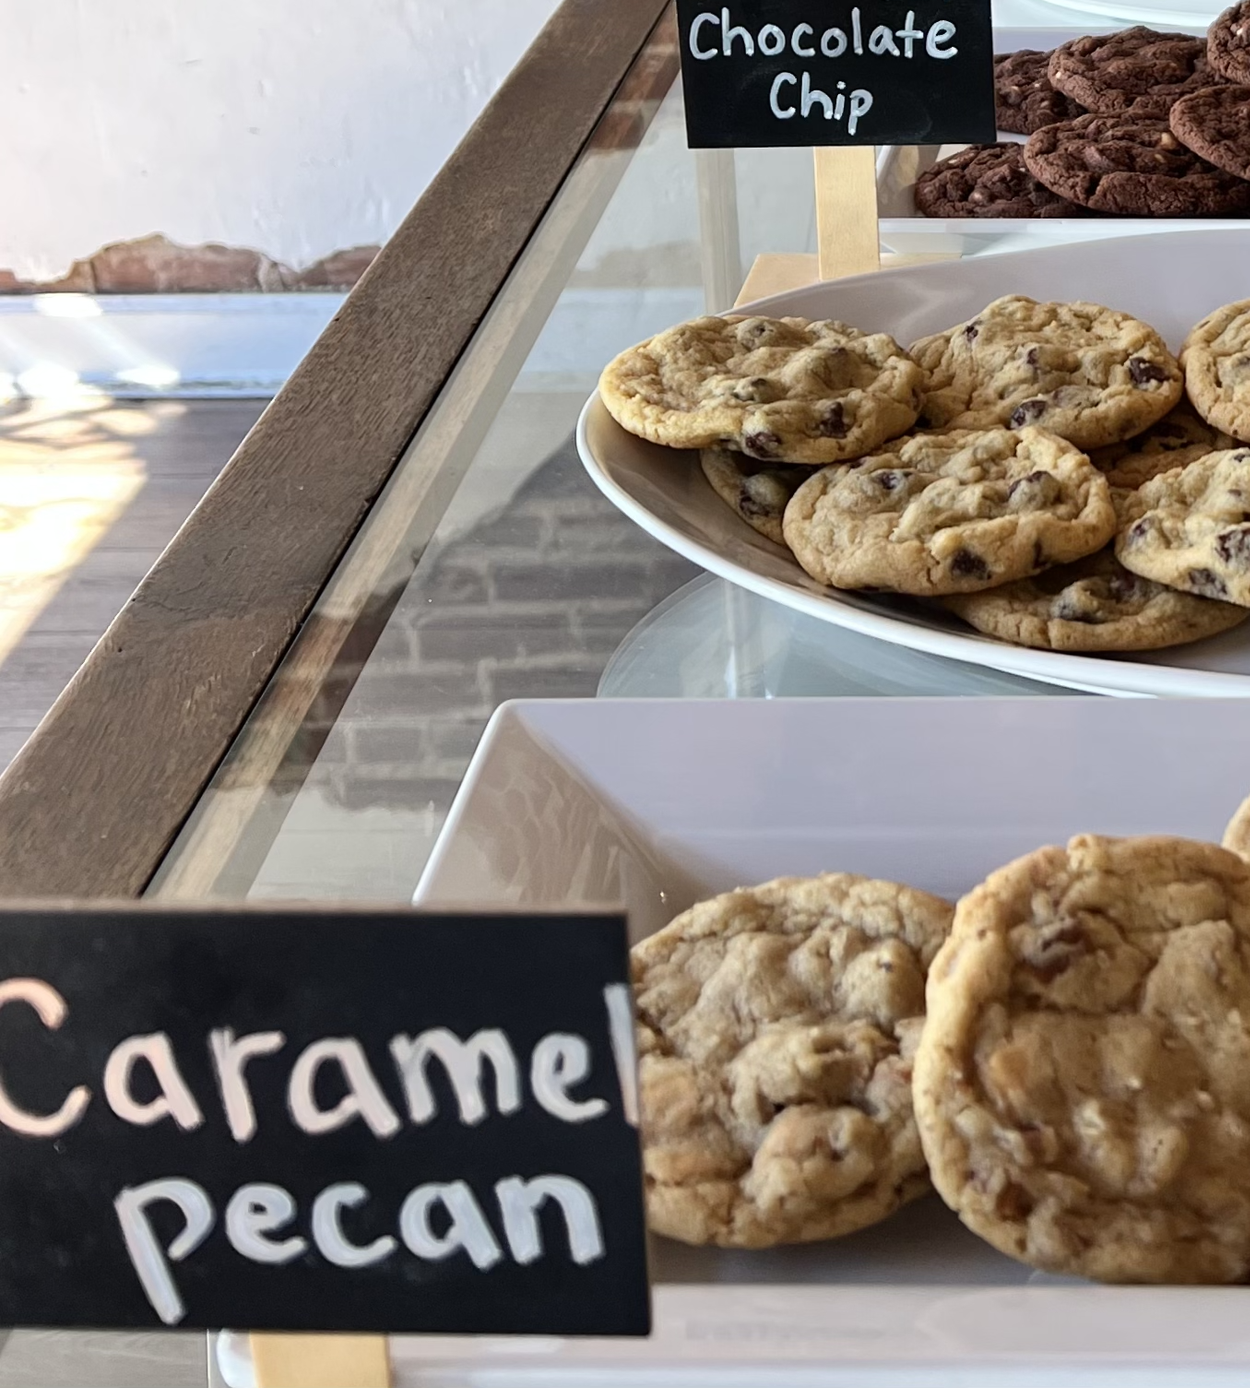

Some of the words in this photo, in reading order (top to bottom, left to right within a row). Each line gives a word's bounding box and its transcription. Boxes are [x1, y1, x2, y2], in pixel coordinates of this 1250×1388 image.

[689, 7, 958, 59] Chocolate
[769, 71, 873, 136] Chip
[0, 977, 638, 1141] Caramel
[114, 1175, 603, 1324] pecan
